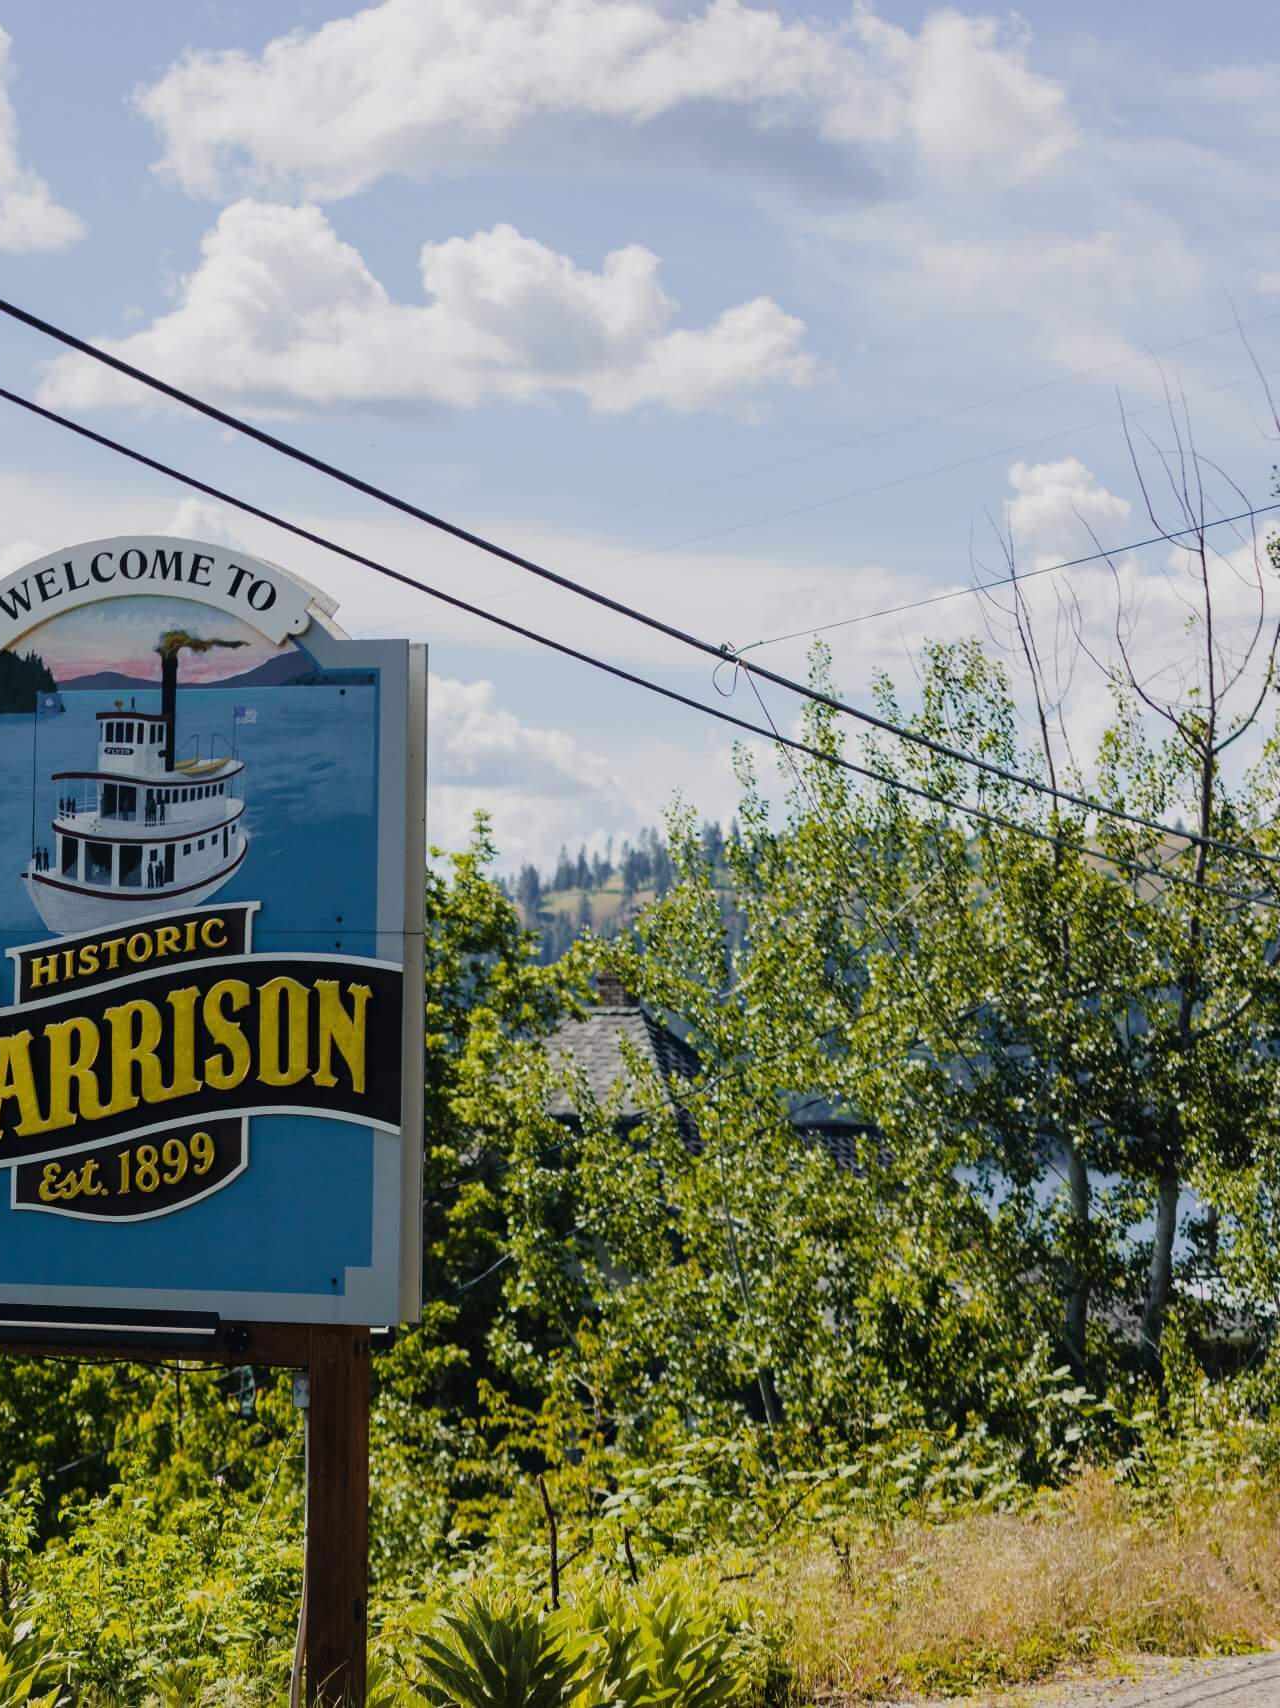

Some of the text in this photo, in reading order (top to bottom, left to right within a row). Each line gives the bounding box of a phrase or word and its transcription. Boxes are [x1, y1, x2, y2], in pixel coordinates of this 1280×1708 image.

[226, 564, 277, 612] TO
[30, 917, 228, 988] HISTORIC
[38, 1131, 216, 1202] Est. 1899
